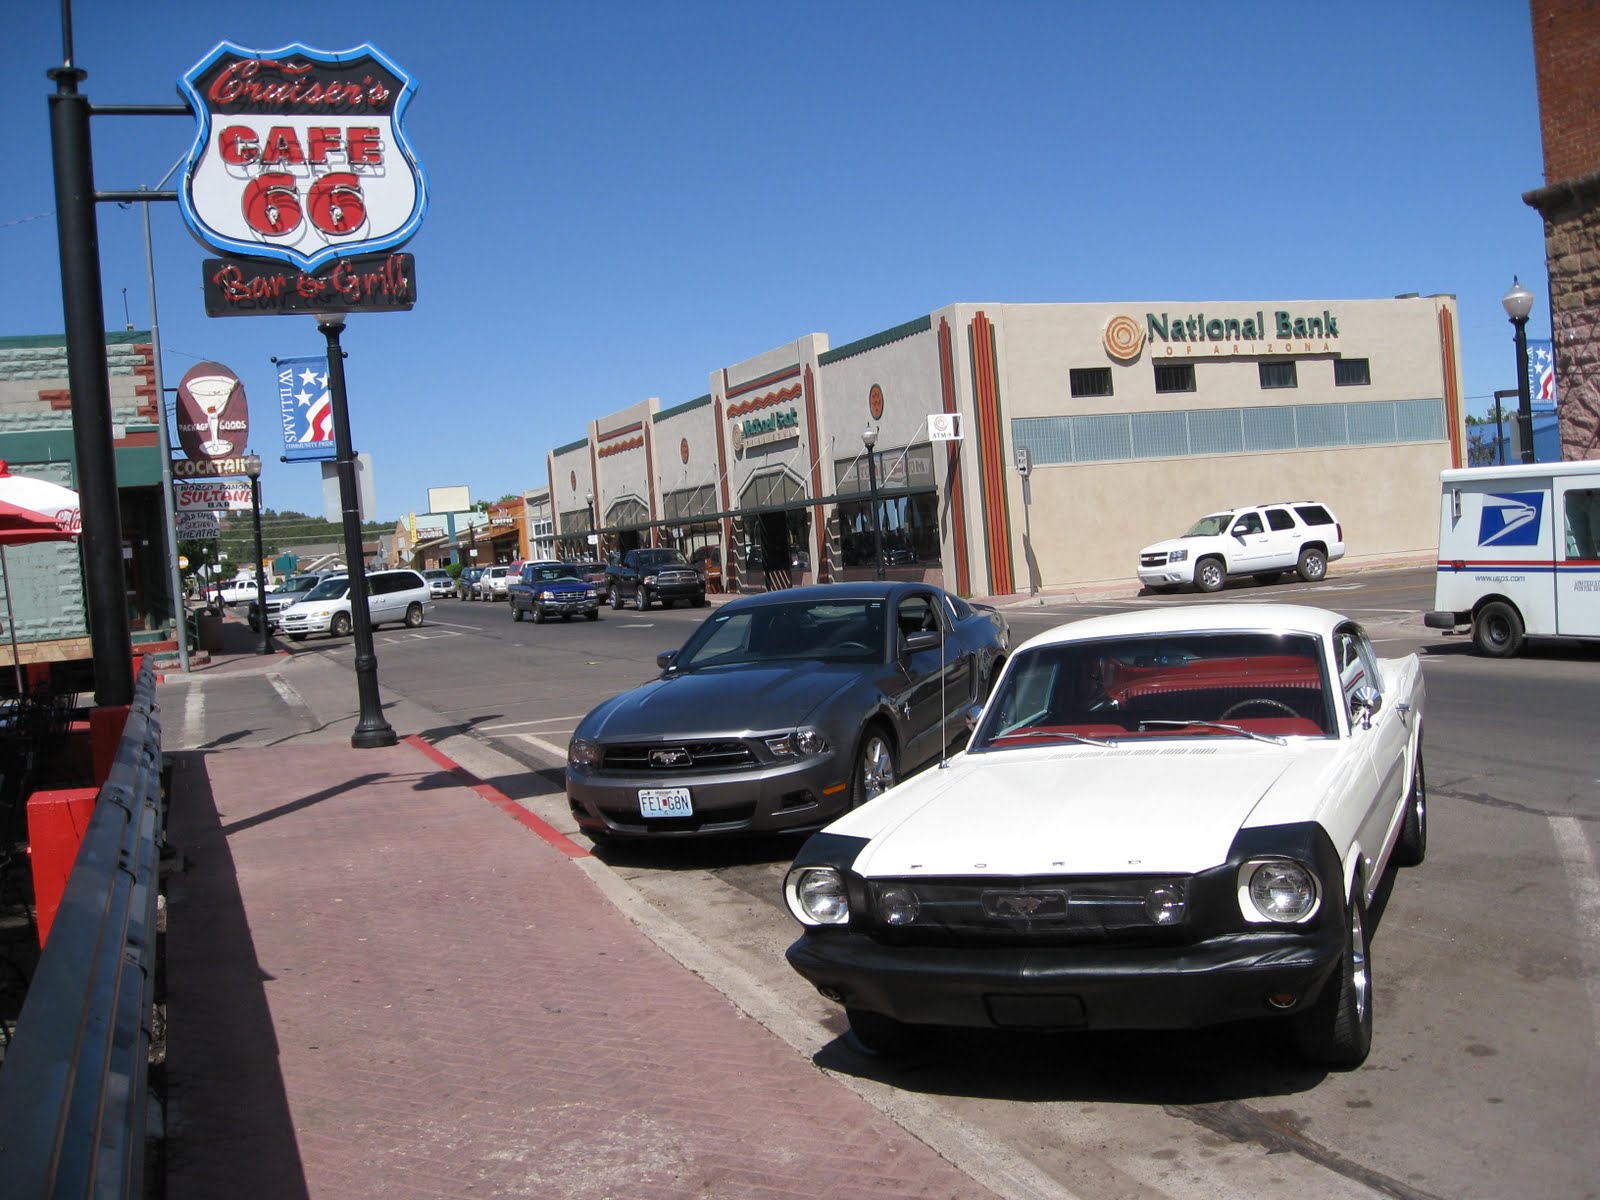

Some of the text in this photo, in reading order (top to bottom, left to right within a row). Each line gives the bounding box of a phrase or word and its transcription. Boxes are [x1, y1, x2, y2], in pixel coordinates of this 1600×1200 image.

[209, 59, 389, 104] Cruiser's
[218, 125, 382, 166] CAFE
[241, 171, 367, 236] 66
[213, 254, 409, 301] Bar & Grill
[1146, 310, 1339, 342] National Bank
[1166, 342, 1330, 356] OF ARIZONA
[278, 368, 297, 443] WILLIAMS
[219, 420, 247, 431] GOODS
[180, 490, 253, 506] SULTANA
[178, 528, 220, 538] THEATRE
[1475, 575, 1526, 583] www.usps.com
